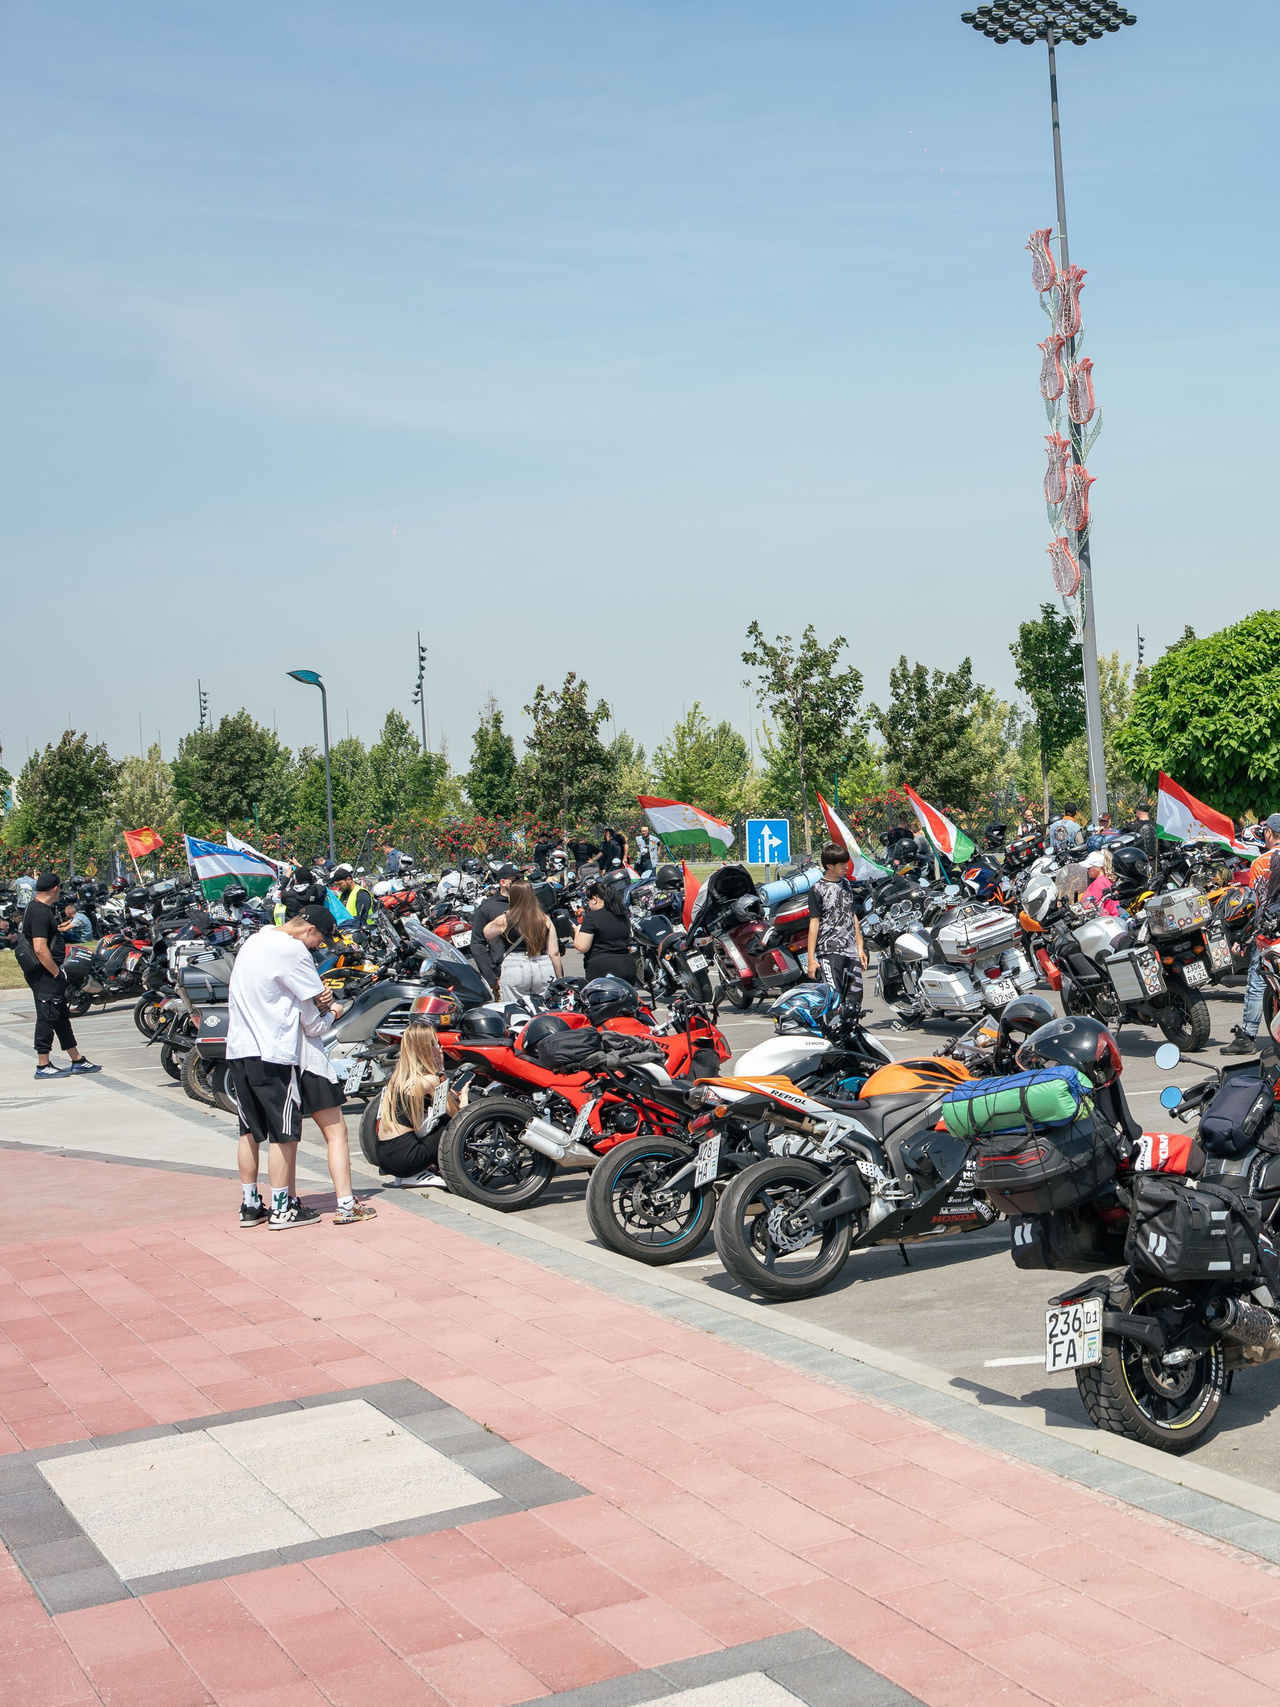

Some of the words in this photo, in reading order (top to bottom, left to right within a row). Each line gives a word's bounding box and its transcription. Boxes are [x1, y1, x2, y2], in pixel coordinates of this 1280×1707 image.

[1186, 963, 1202, 974] 2306
[998, 980, 1011, 991] 93
[993, 995, 1005, 1005] 02
[771, 1090, 806, 1105] REPSOL
[931, 1213, 978, 1223] HONDA
[1048, 1308, 1082, 1338] 236
[1086, 1310, 1098, 1325] 01
[1052, 1338, 1077, 1367] FA
